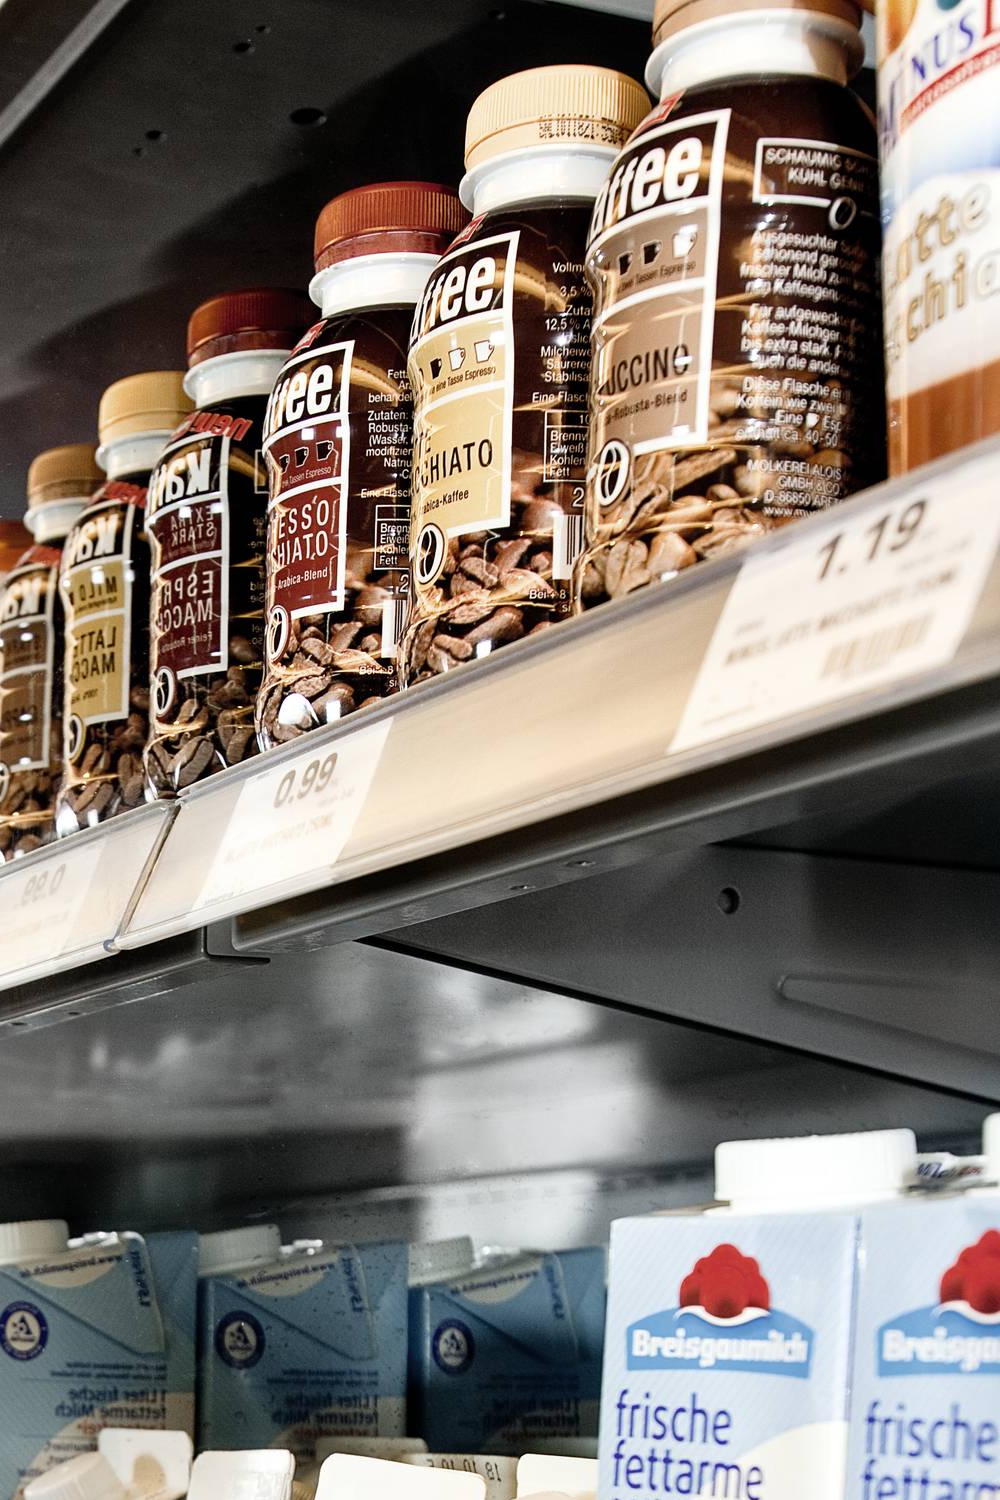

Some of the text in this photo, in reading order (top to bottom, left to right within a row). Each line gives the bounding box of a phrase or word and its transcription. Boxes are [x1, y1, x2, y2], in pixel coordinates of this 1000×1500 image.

[763, 337, 798, 353] extra
[786, 354, 808, 369] die
[782, 377, 830, 396] Flasche
[785, 398, 808, 410] wie
[368, 423, 413, 434] Robusta-
[549, 466, 571, 478] Fett
[747, 458, 842, 480] MOLKEREI ALOIS
[777, 475, 814, 490] GMBH
[816, 499, 928, 582] 1.19
[379, 555, 398, 565] Fett
[272, 751, 340, 810] 0.99
[632, 1328, 808, 1365] Breisgaumilch
[616, 1390, 732, 1446] frische
[866, 1401, 998, 1461] frische
